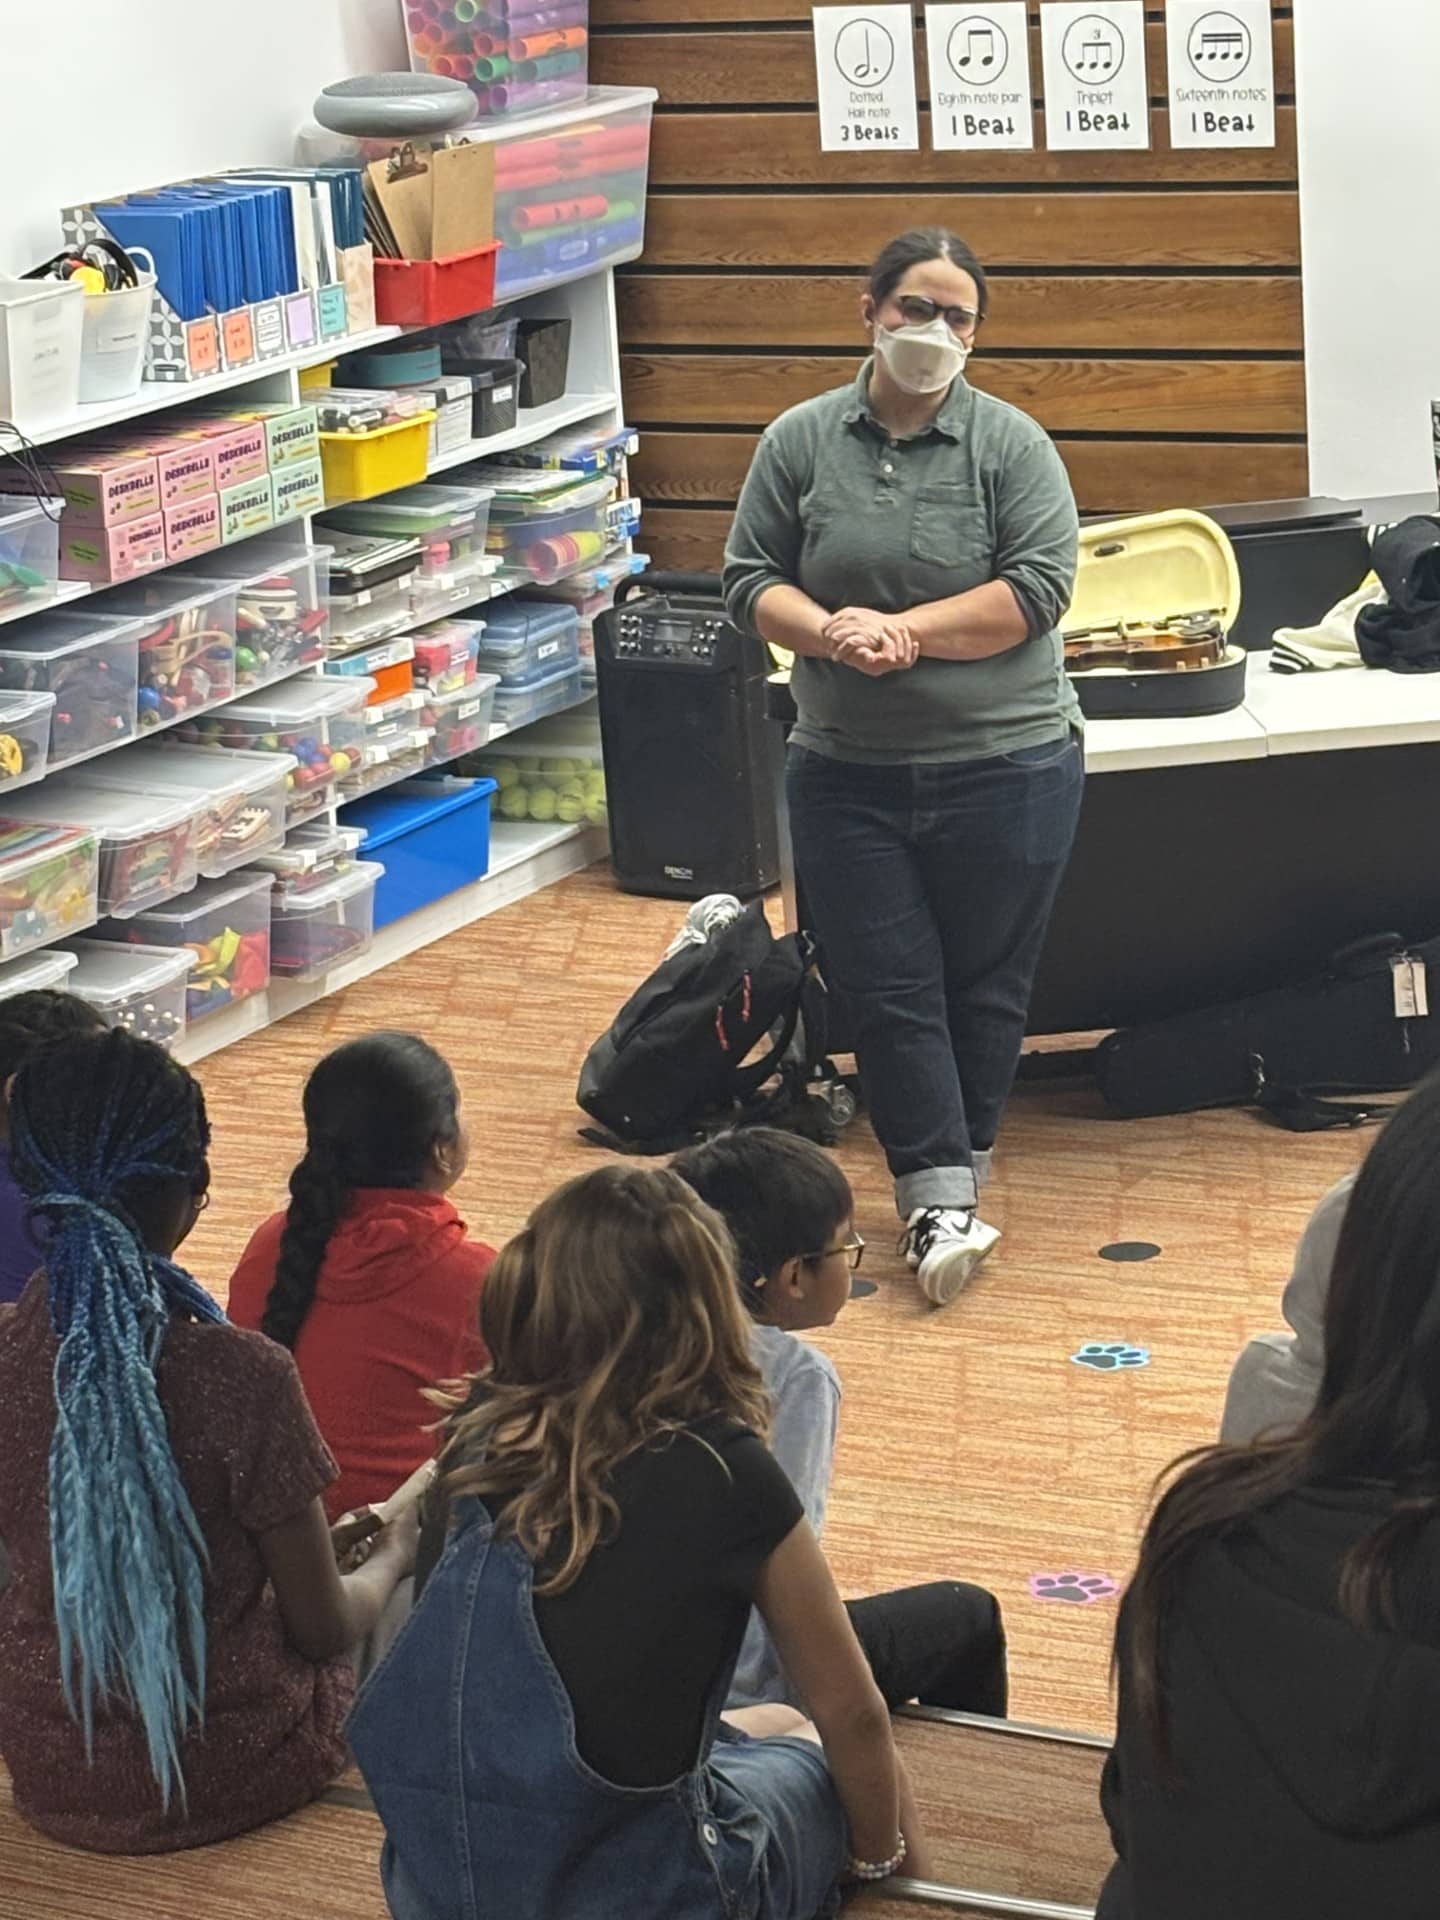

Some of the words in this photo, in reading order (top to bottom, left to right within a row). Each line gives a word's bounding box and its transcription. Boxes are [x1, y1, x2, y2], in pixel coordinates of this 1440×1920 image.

[849, 91, 884, 103] Dotted
[937, 92, 972, 108] Eighth
[973, 92, 999, 105] note
[1000, 92, 1023, 105] pair
[1077, 90, 1112, 106] Triplet
[1176, 87, 1230, 102] Sixteenth
[1232, 87, 1267, 101] notes
[867, 107, 890, 118] note
[1078, 110, 1130, 131] Beat
[963, 114, 1015, 136] Beat
[1203, 111, 1255, 133] Beat
[840, 125, 849, 141] 3
[854, 124, 899, 140] Beats
